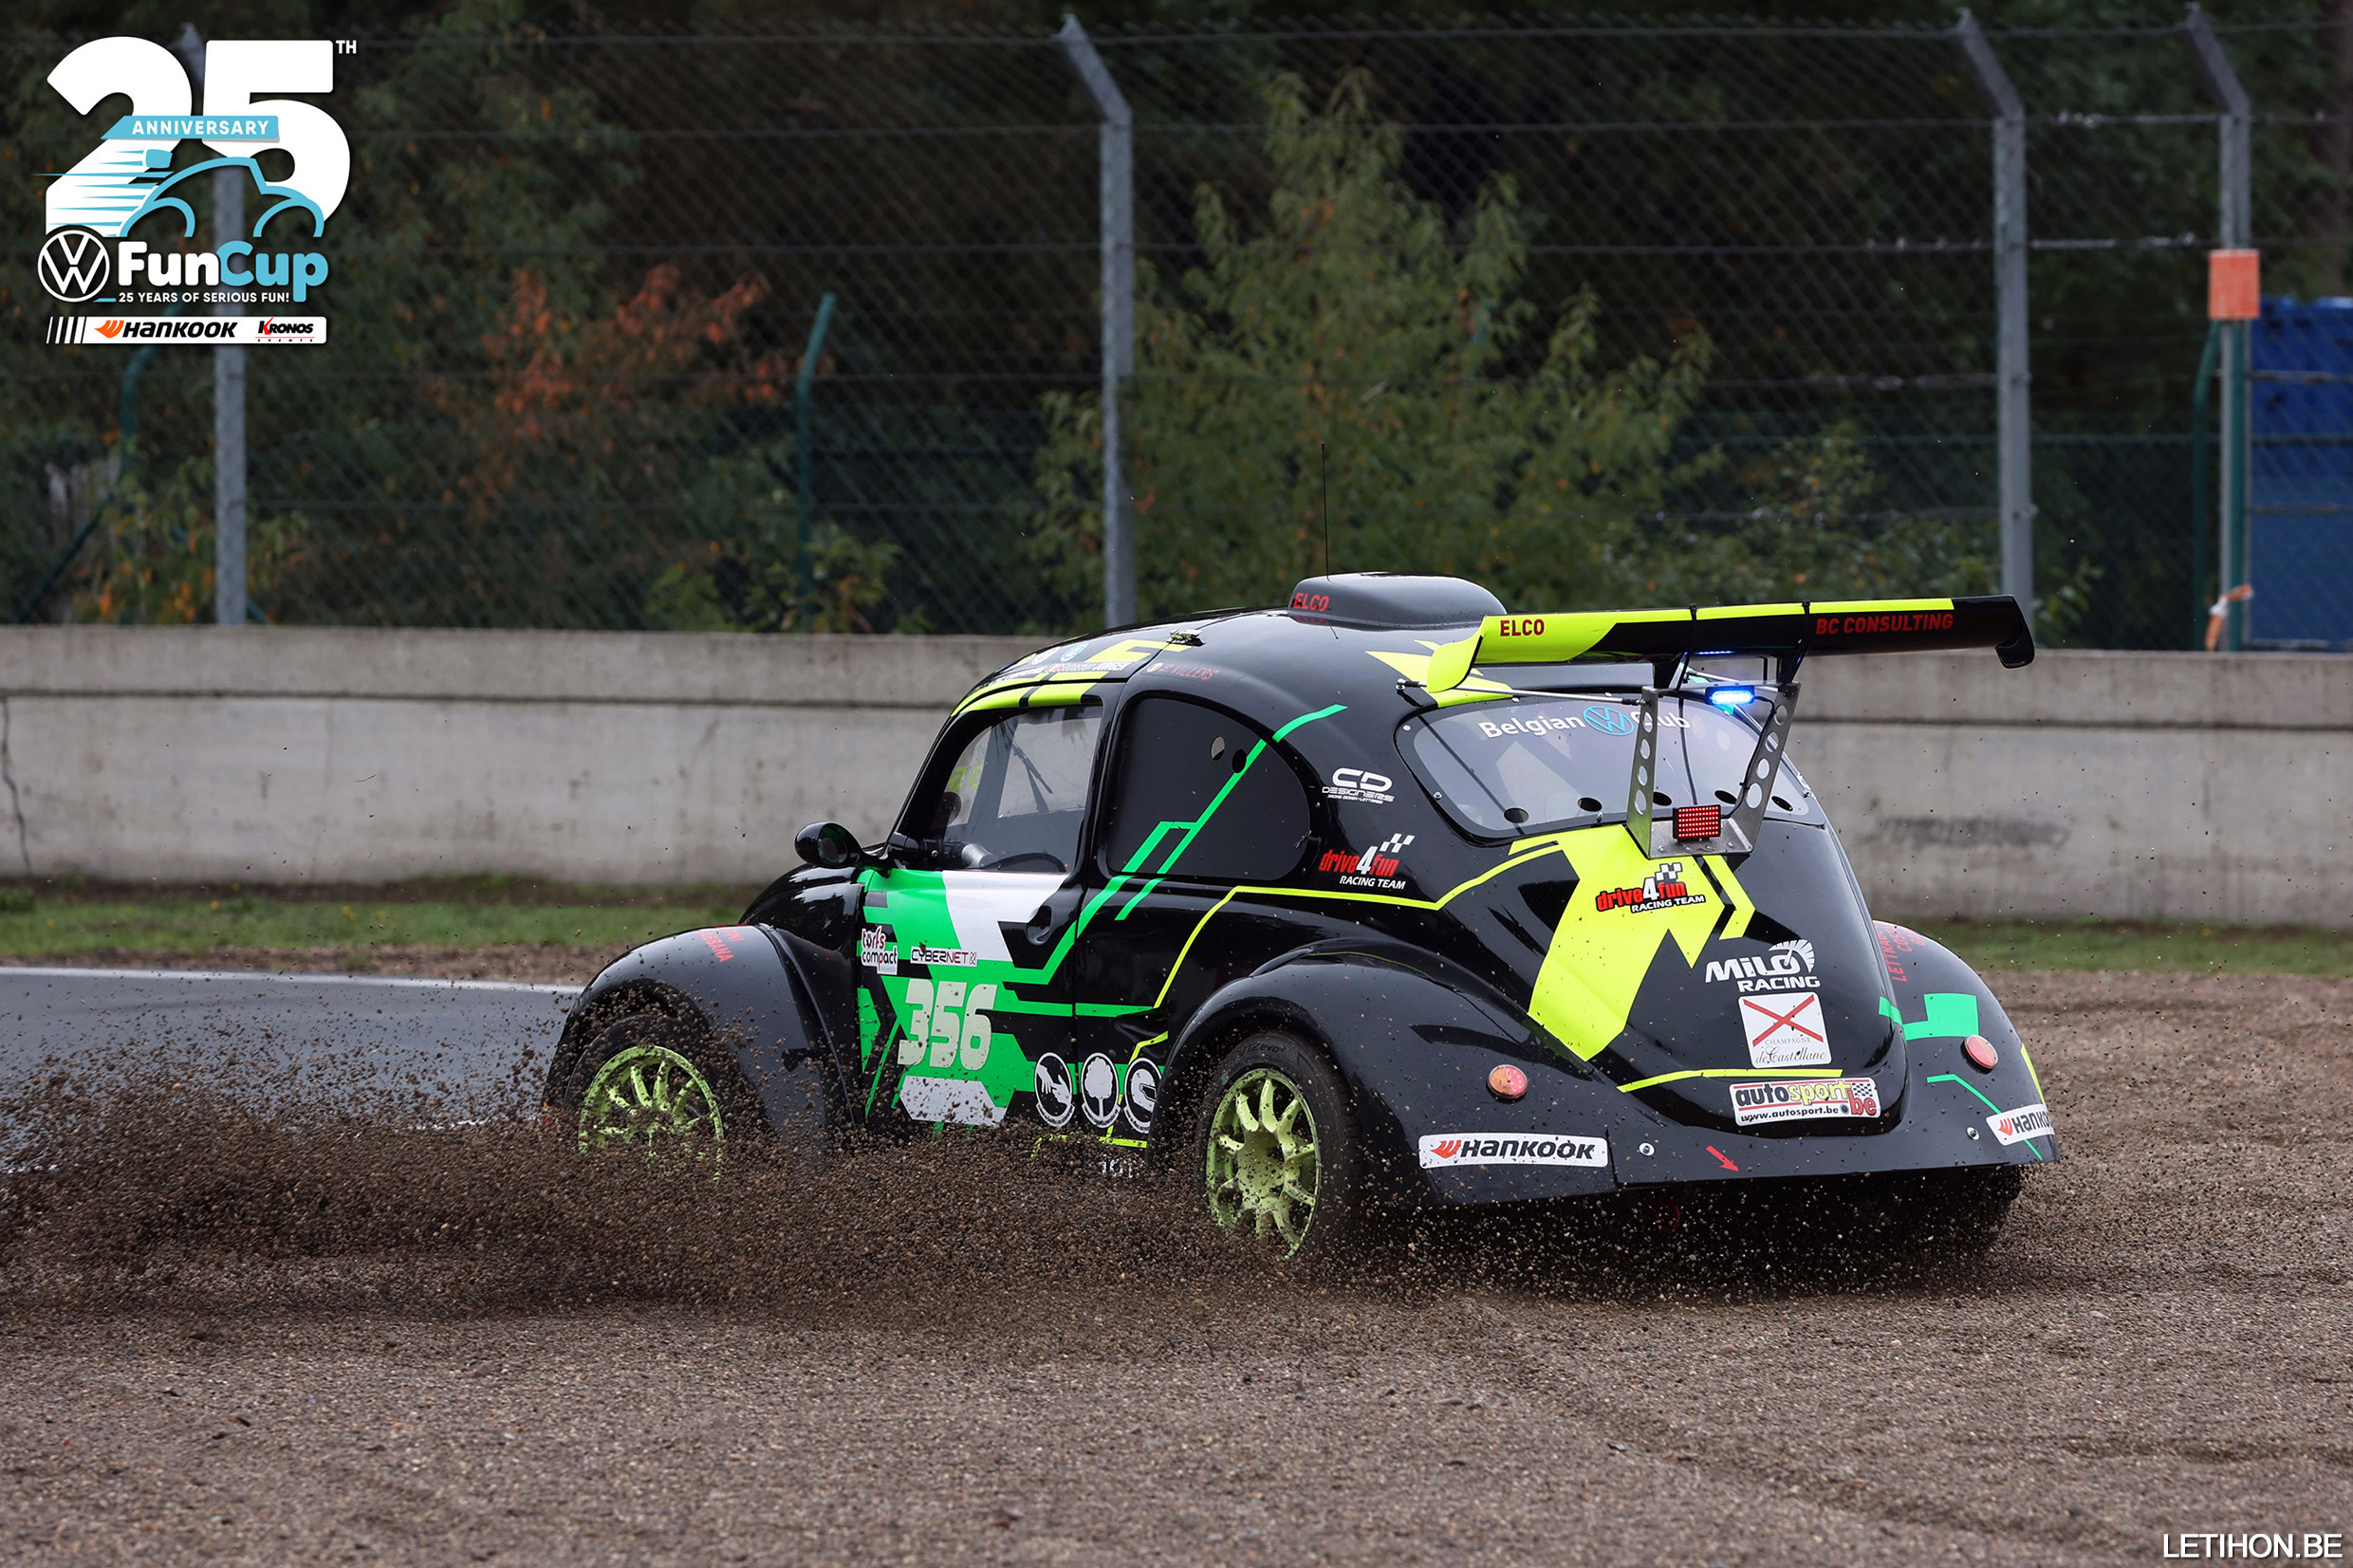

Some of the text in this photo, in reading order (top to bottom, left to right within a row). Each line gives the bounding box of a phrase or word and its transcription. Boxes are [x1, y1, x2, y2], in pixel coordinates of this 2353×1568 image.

[1292, 592, 1330, 612] ELCO
[1500, 618, 1545, 636] ELCO
[1815, 614, 1955, 635] BC CONSULTING
[1478, 715, 1585, 738] Belgian
[1332, 767, 1393, 792] CD
[1322, 786, 1396, 802] DESIGNERS
[1319, 846, 1399, 877] drive4fun
[1340, 876, 1406, 890] RACING TEAM
[1596, 876, 1687, 912] drive4fun
[1631, 895, 1705, 913] RACING TEAM
[862, 947, 898, 971] compact
[1737, 976, 1821, 992] RACING
[898, 978, 997, 1071] 356
[1765, 1037, 1812, 1045] CHAMPAGNE
[1740, 1105, 1839, 1123] www.autosport.be
